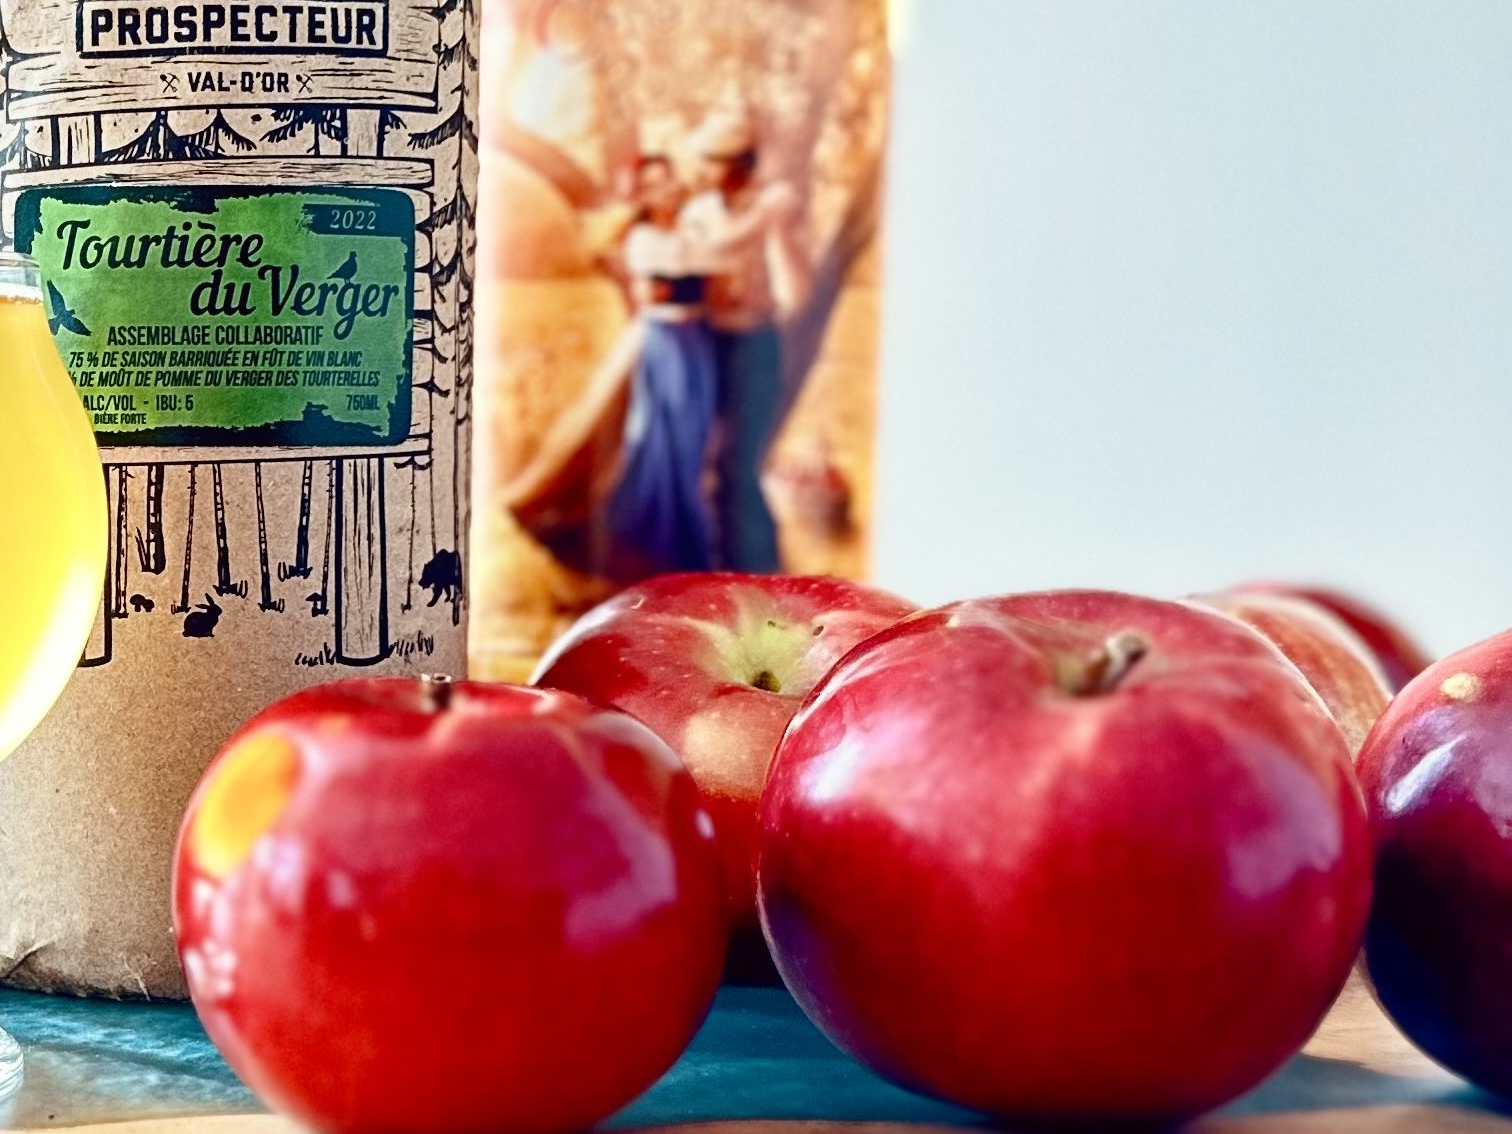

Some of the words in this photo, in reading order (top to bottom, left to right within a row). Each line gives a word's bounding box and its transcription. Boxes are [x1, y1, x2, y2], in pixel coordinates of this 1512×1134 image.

[90, 4, 377, 46] PROSPECTEUR
[187, 71, 290, 93] VAL-D'OR
[329, 209, 377, 230] 2022
[56, 219, 264, 270] Tourtière
[190, 268, 256, 316] du
[257, 264, 399, 340] Verger
[107, 325, 211, 346] ASSEMBLAGE
[215, 325, 324, 346] COLLABORATIF
[69, 351, 84, 367] 75
[87, 351, 99, 367] %
[101, 351, 118, 367] DE
[120, 351, 167, 367] SAISON
[168, 348, 241, 367] BARRIQUÉE
[242, 351, 259, 367] EN
[262, 348, 286, 367] FÛT
[288, 351, 303, 367] DE
[305, 351, 326, 367] VIN
[327, 351, 363, 367] BLANC
[79, 371, 96, 387] DE
[98, 368, 134, 387] MOÛT
[134, 370, 153, 387] DE
[154, 370, 202, 387] POMME
[204, 370, 223, 387] DU
[225, 370, 273, 387] VERGER
[276, 370, 299, 387] DES
[302, 370, 381, 387] TOURTERELLES
[156, 394, 182, 411] IBU:
[185, 394, 194, 411] 5
[94, 411, 118, 424] BIÈRE
[120, 413, 147, 424] FORTE
